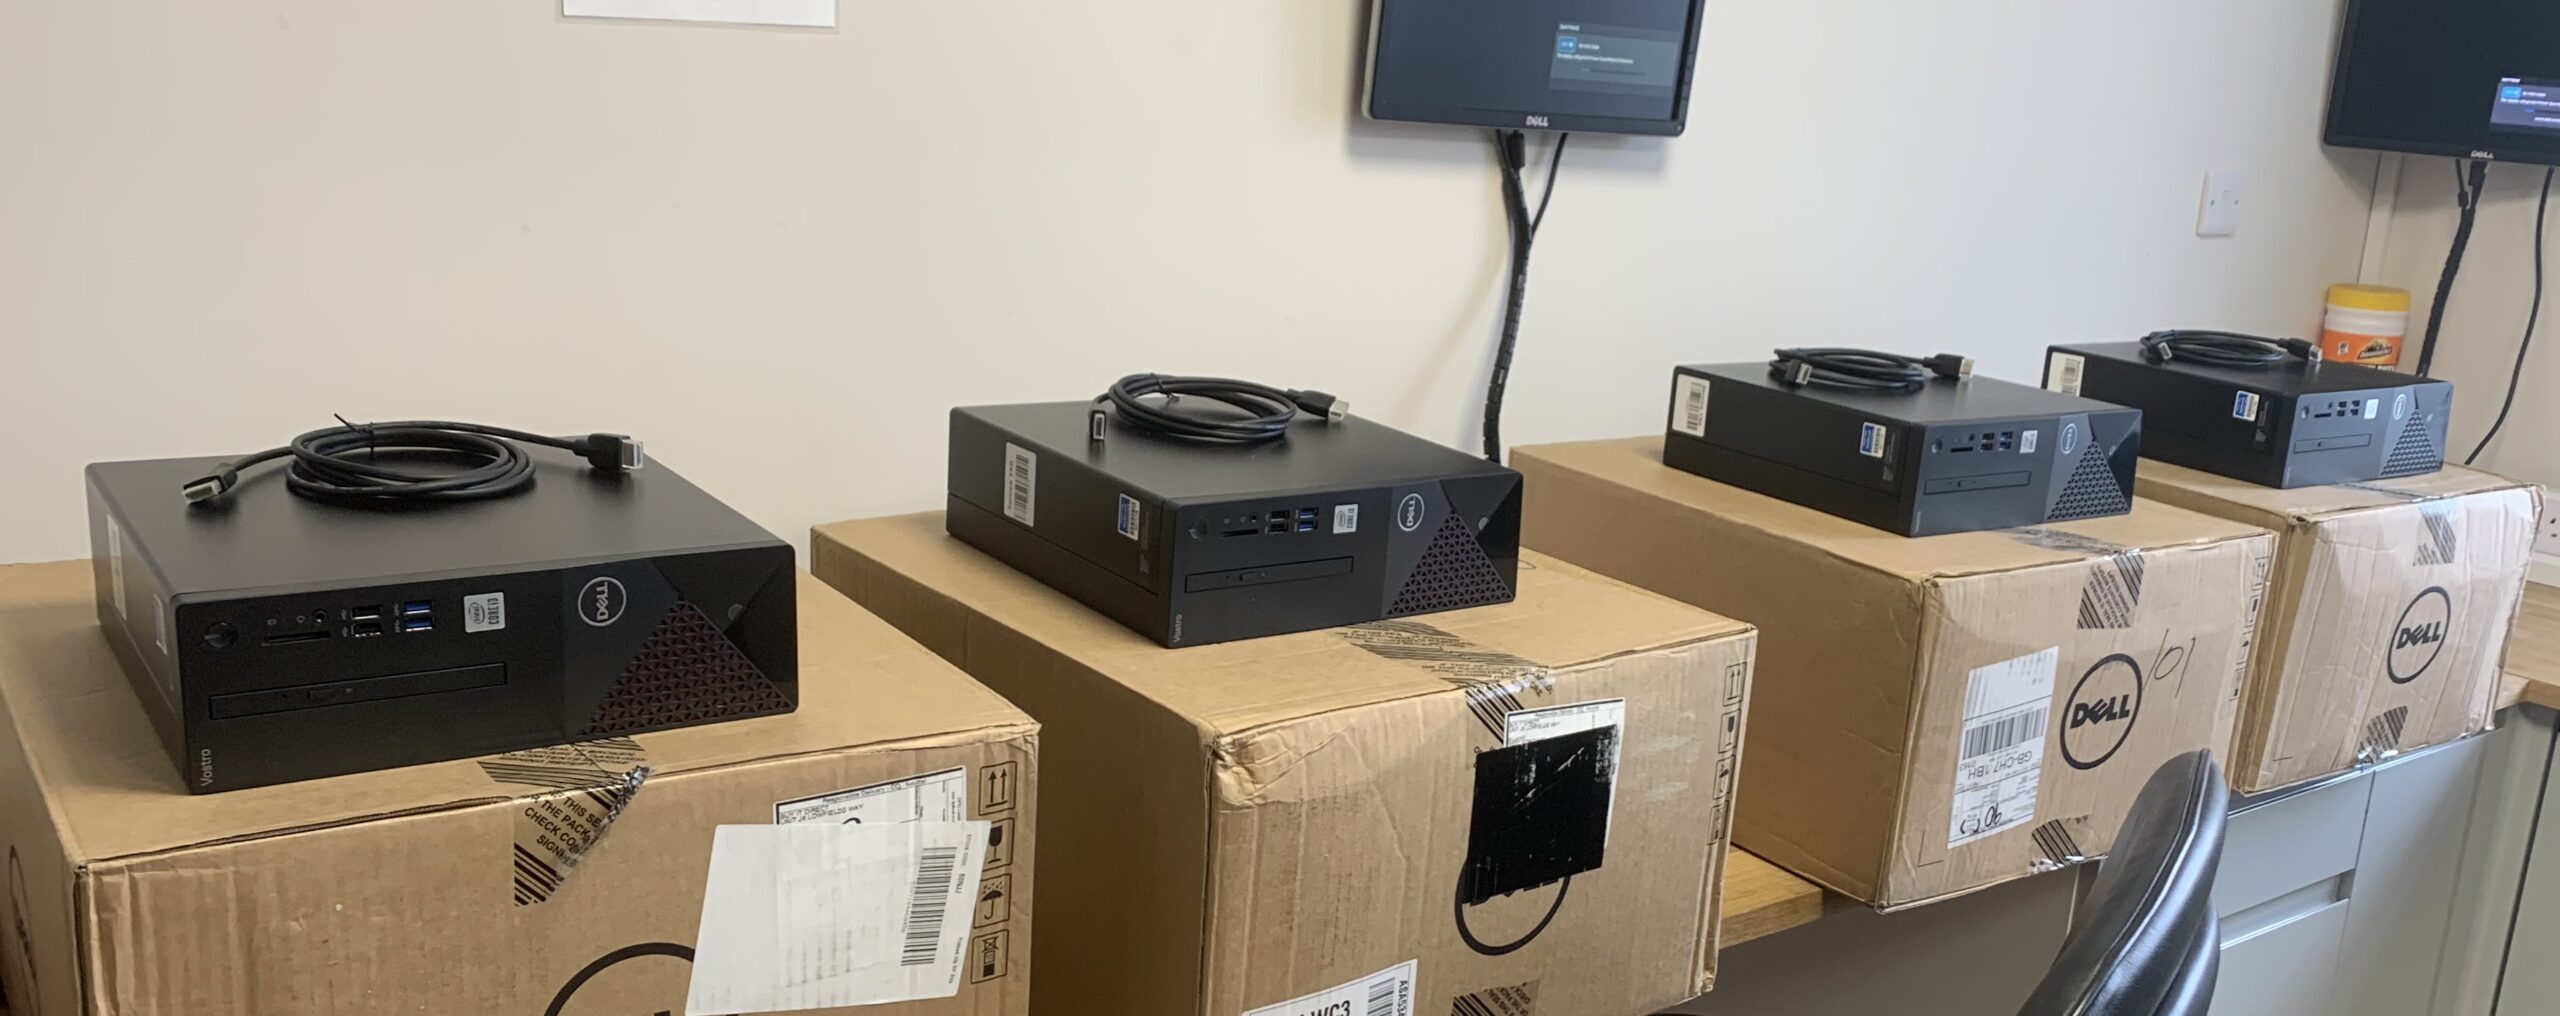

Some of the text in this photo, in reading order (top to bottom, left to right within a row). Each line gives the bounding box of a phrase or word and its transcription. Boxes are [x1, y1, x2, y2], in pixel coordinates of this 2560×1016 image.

[1526, 116, 1549, 127] DELL
[1407, 496, 1416, 527] DELL
[596, 582, 609, 621] DELL
[2396, 621, 2441, 650] DELL
[2070, 694, 2130, 729] DELL
[200, 748, 213, 786] Vostro
[525, 807, 559, 836] CHECK
[541, 800, 591, 838] THE PACK
[563, 797, 601, 828] THIS SE
